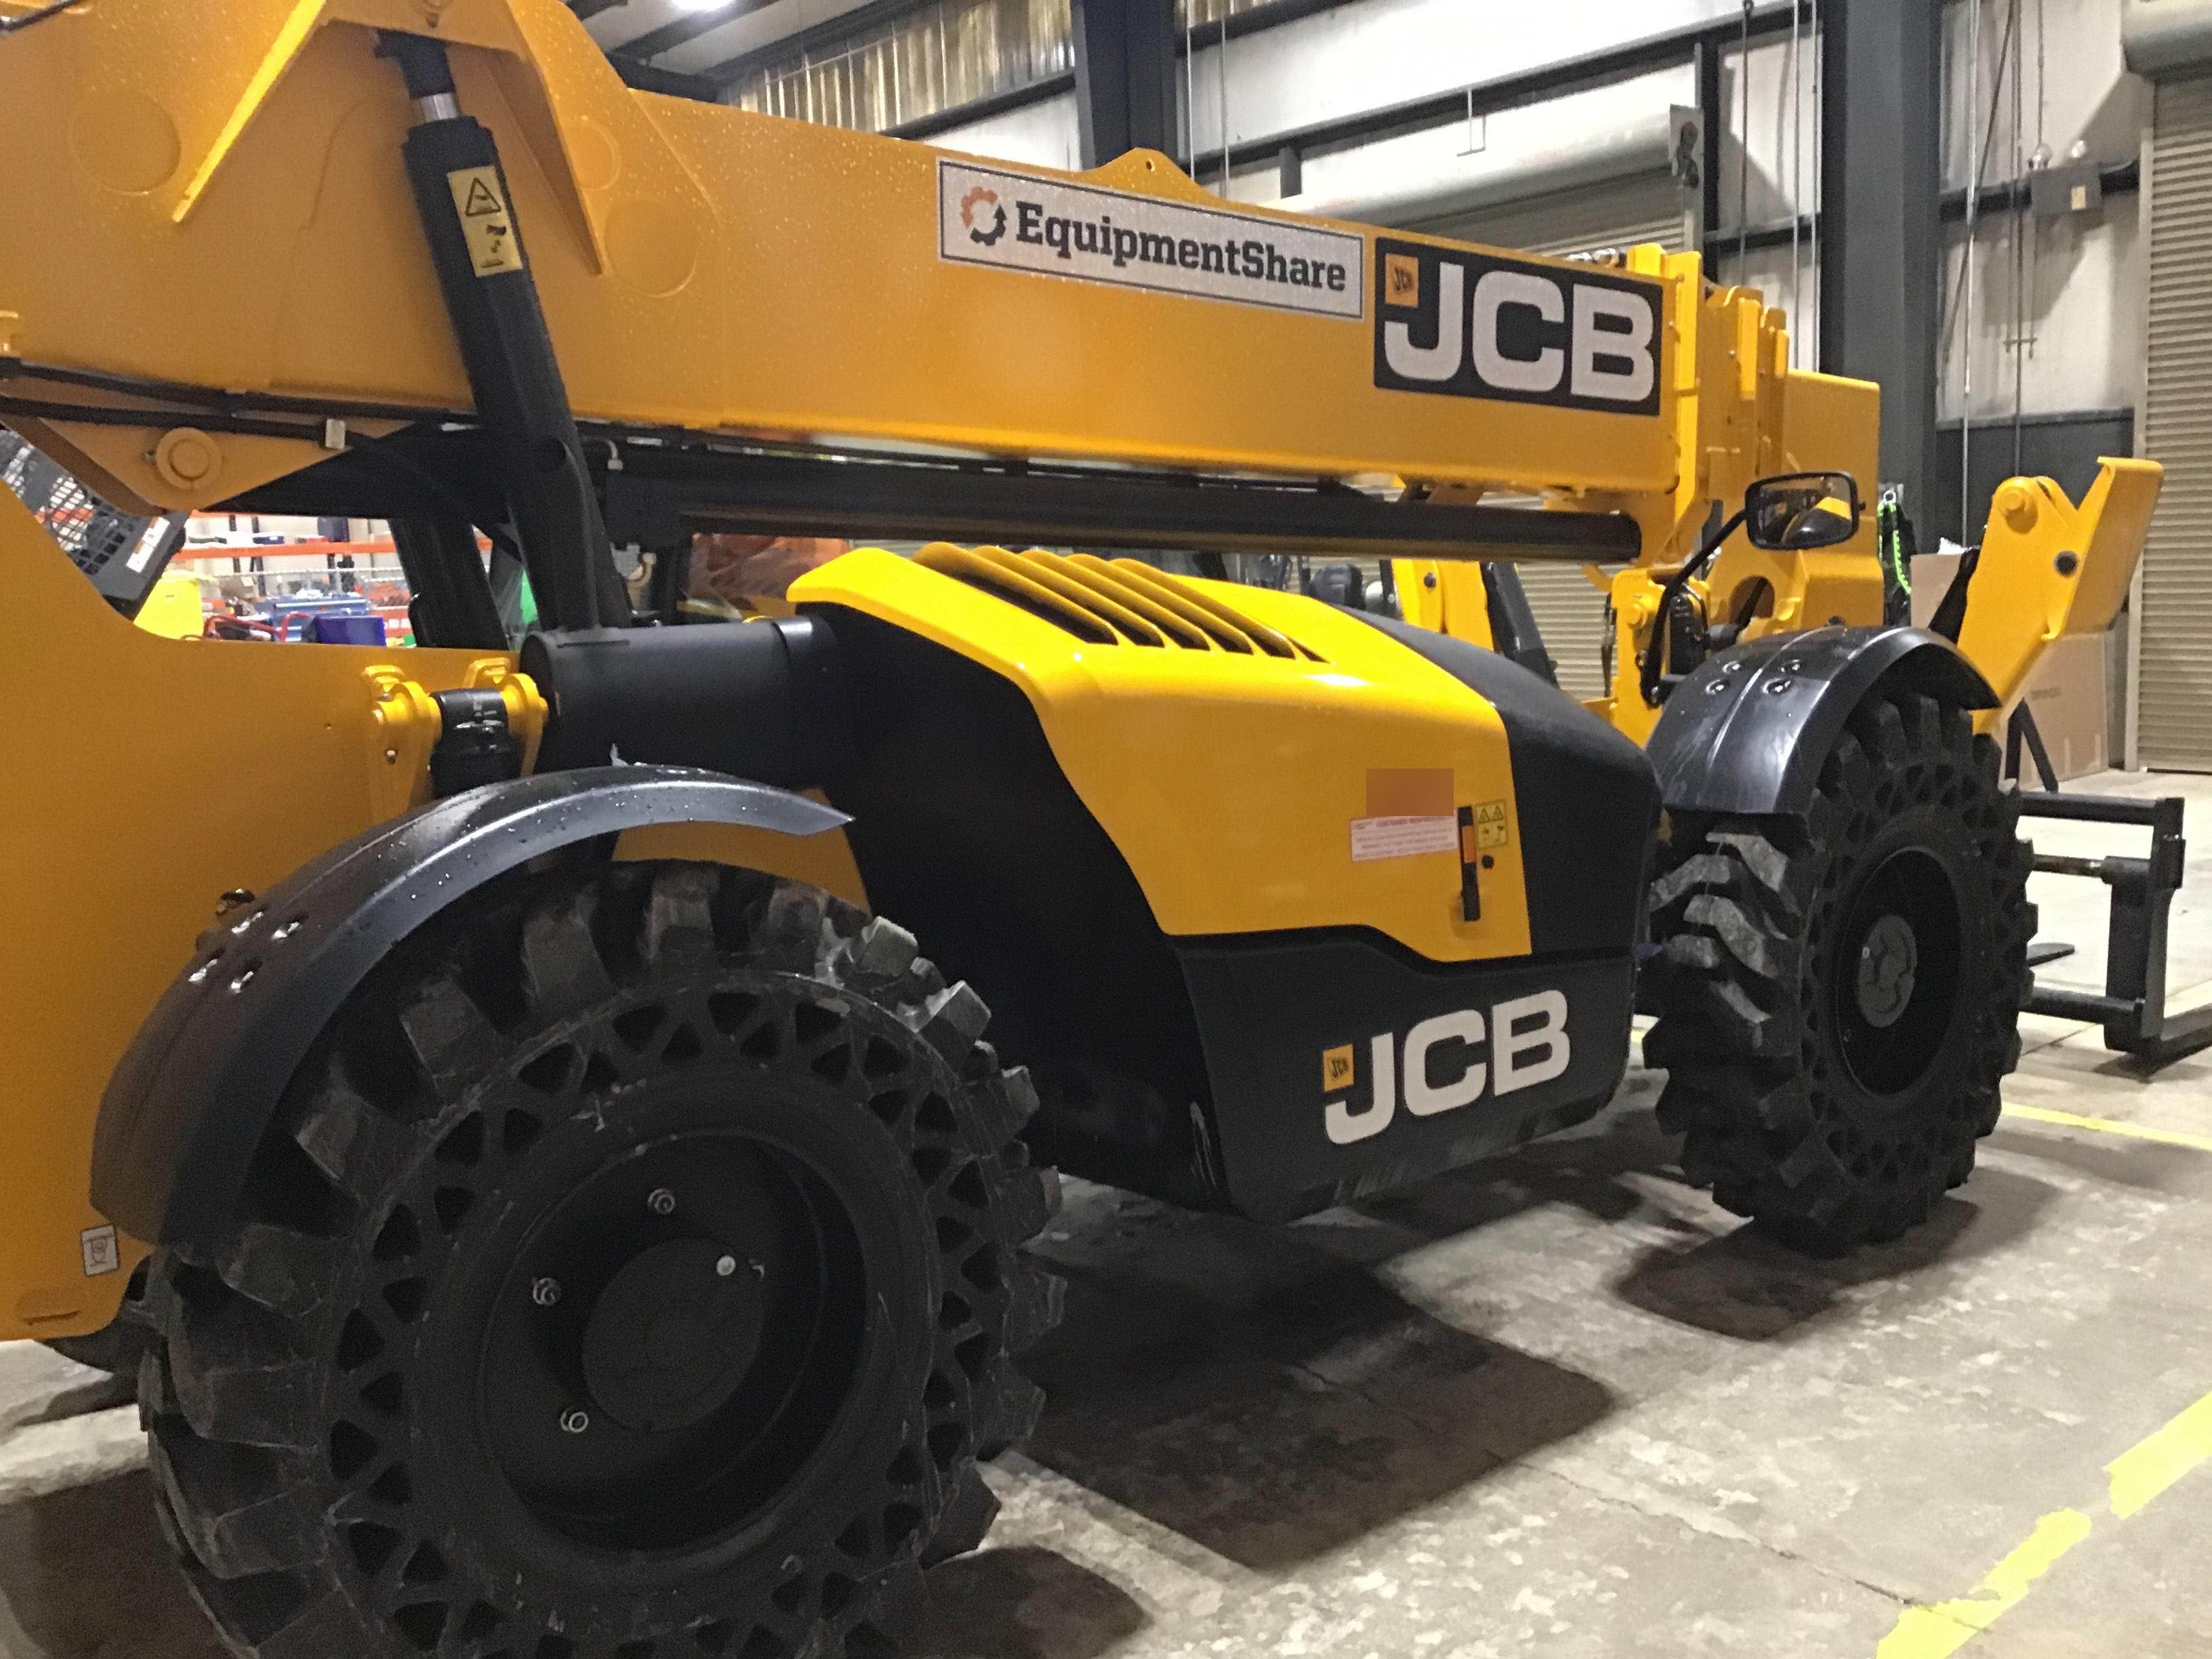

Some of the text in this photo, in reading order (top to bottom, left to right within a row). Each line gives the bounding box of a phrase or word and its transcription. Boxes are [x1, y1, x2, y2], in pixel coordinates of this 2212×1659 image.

[1017, 200, 1347, 292] EquipmentShare
[1385, 262, 1654, 402] JCB
[1325, 989, 1570, 1145] JCB
